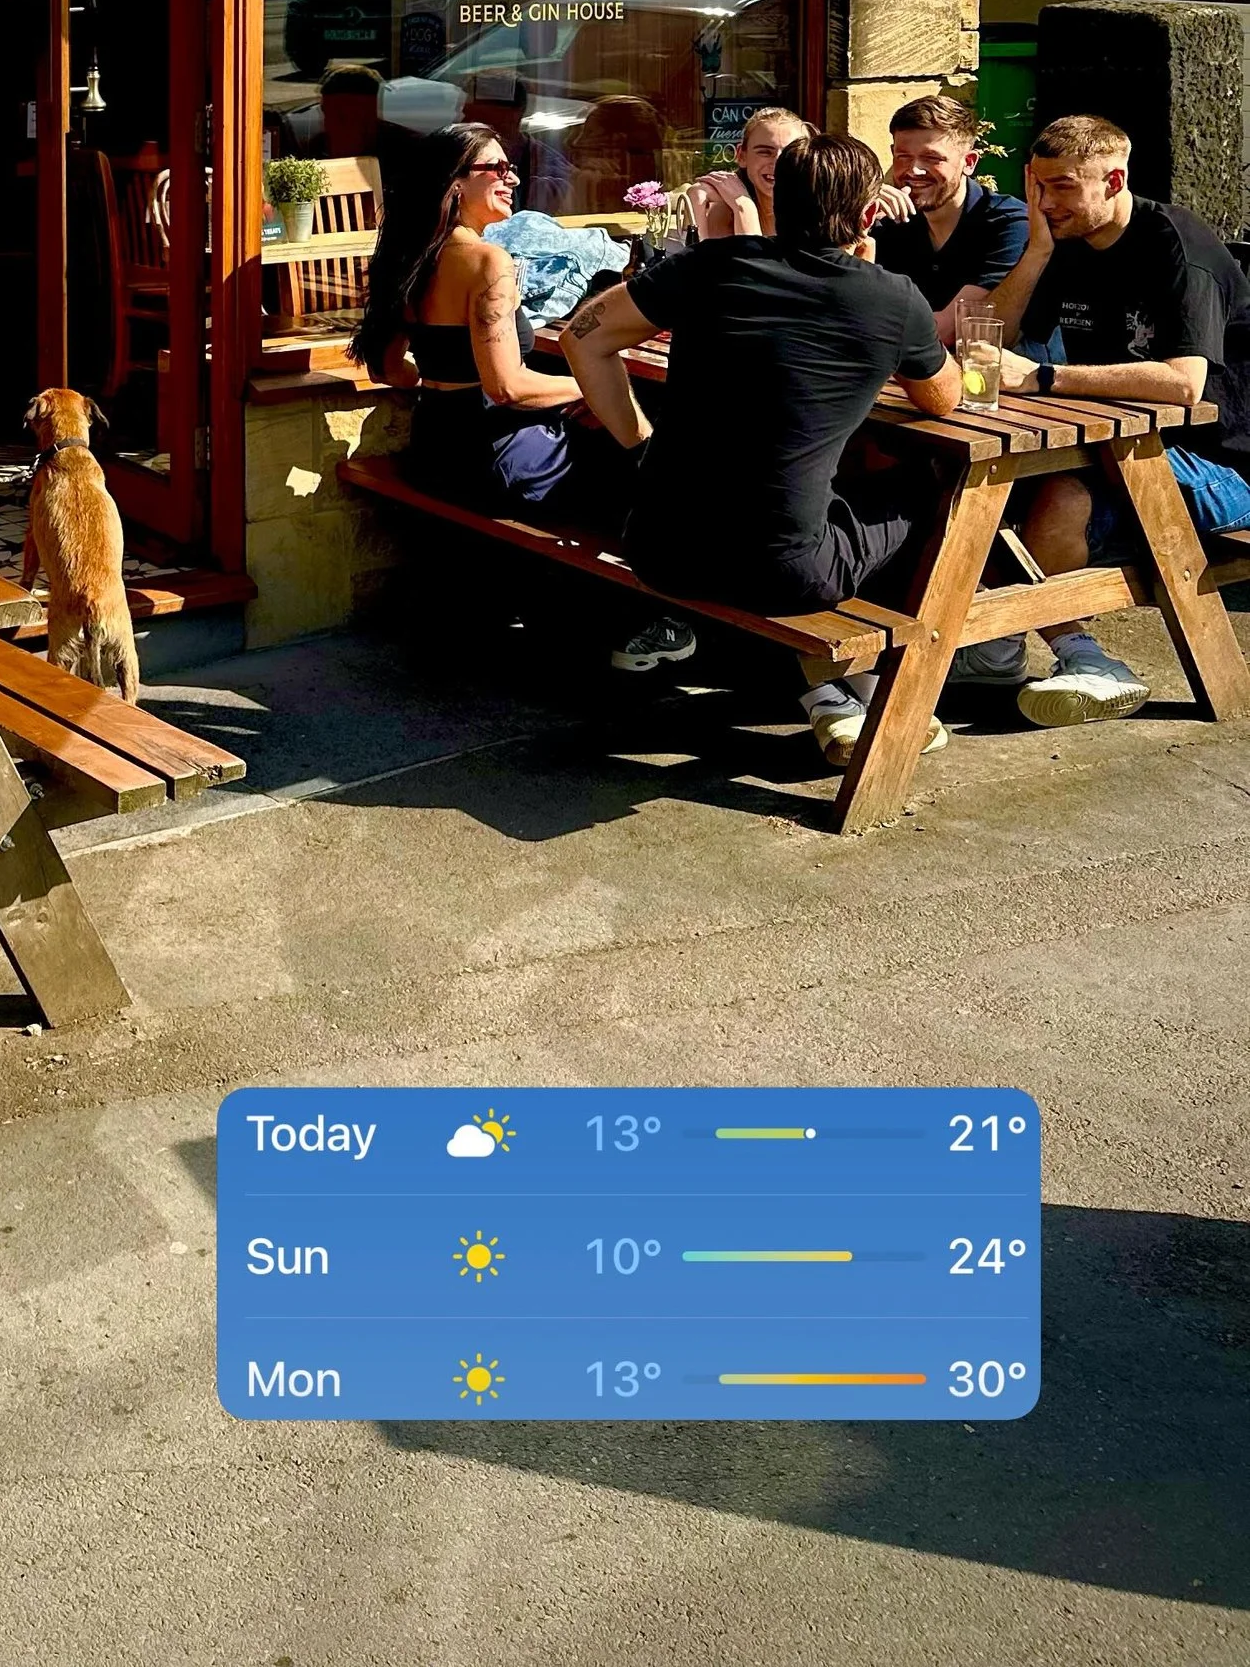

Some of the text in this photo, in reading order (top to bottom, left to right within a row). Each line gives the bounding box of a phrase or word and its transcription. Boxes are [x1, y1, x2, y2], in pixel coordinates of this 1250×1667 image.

[460, 4, 517, 27] BEER
[511, 6, 523, 23] &
[529, 3, 560, 22] GIN
[567, 1, 625, 21] HOUSE
[712, 106, 739, 123] CAN
